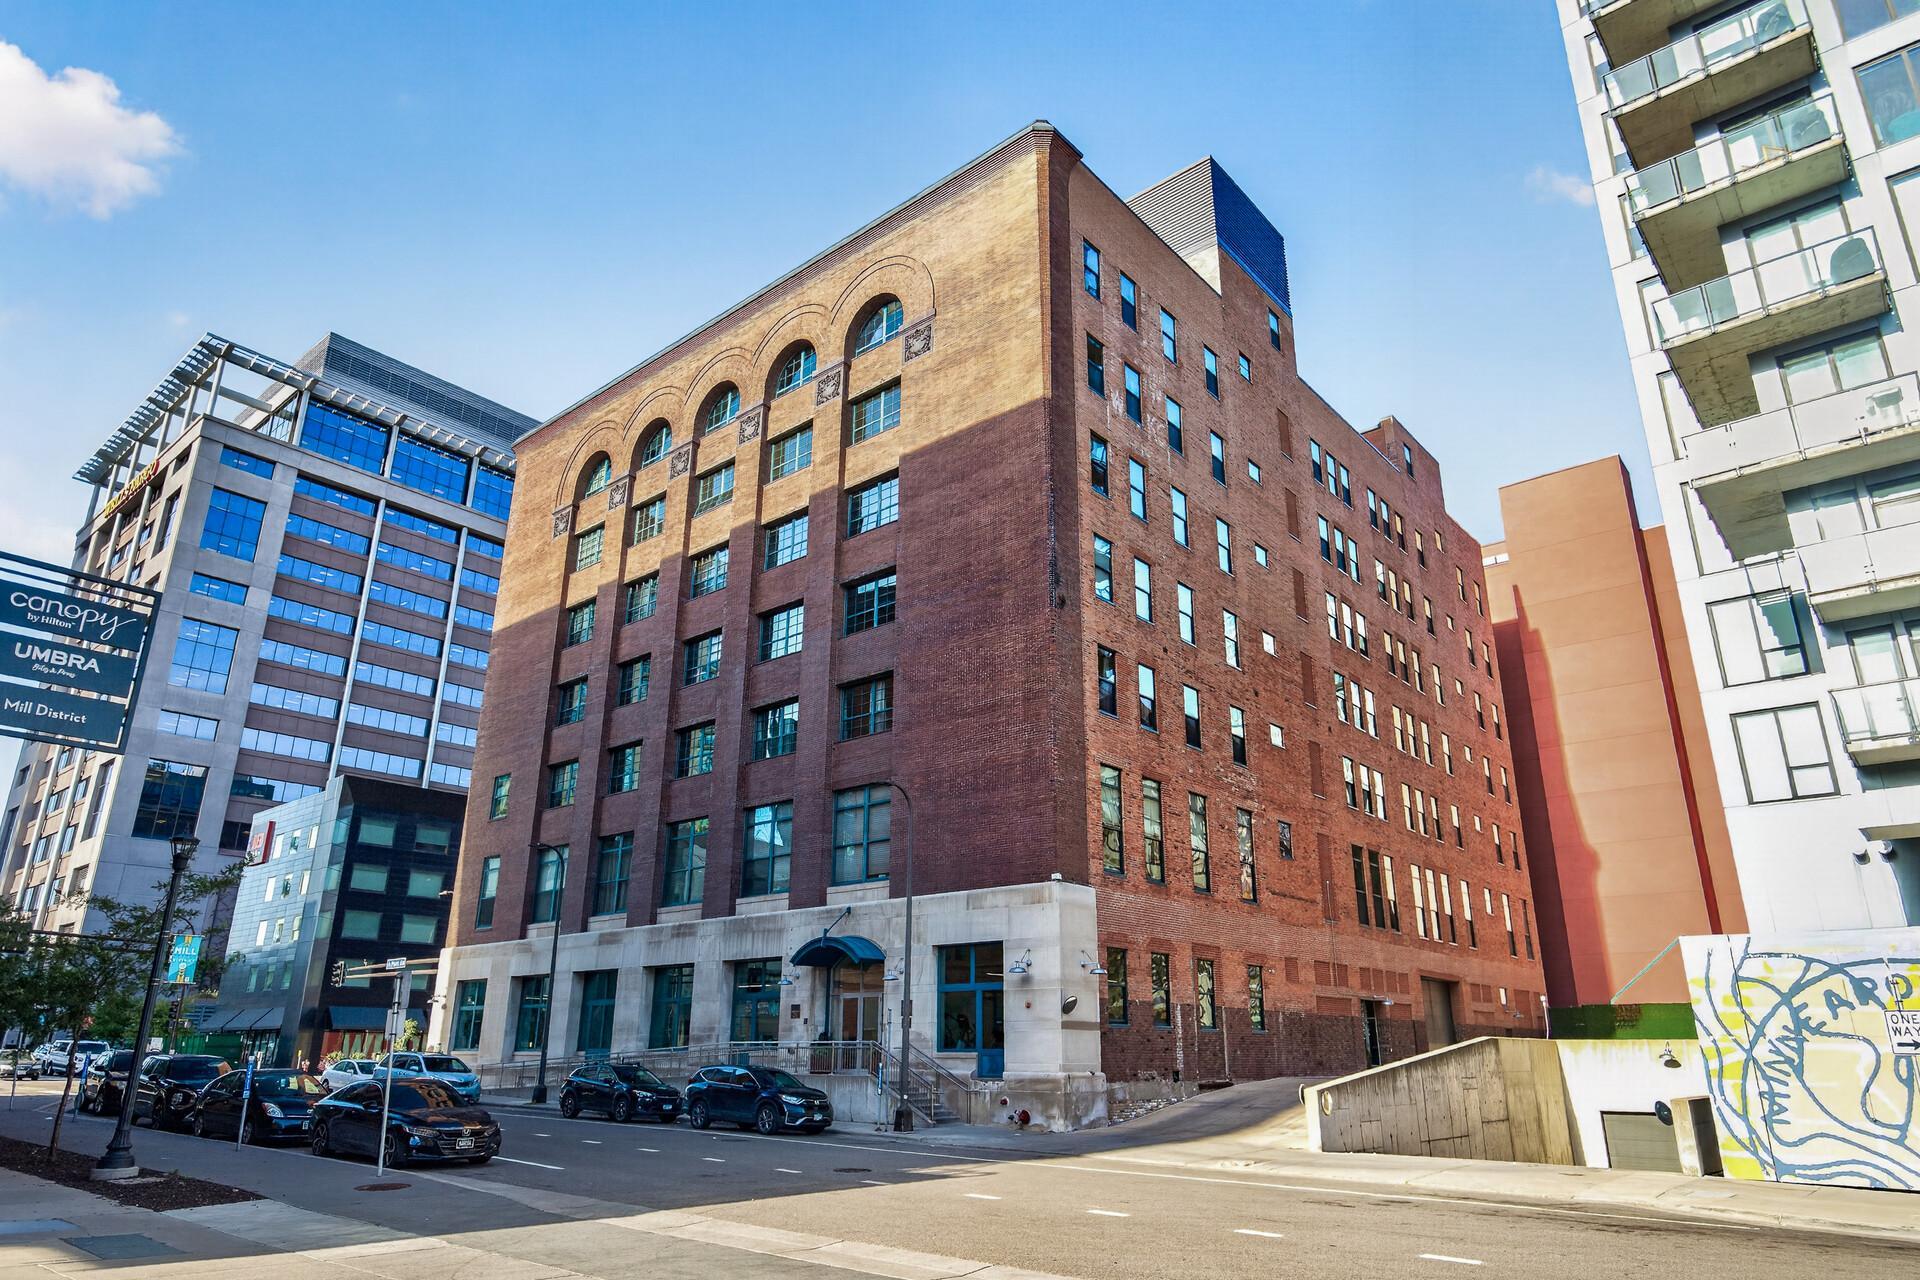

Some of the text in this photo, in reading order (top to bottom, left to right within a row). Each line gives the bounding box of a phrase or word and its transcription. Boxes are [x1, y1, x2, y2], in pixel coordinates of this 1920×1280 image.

[10, 592, 136, 640] canopy
[27, 612, 40, 623] by
[14, 642, 100, 674] UMBRA
[4, 698, 88, 724] Mill District
[174, 946, 197, 955] MILL
[1890, 1013, 1920, 1025] ONE
